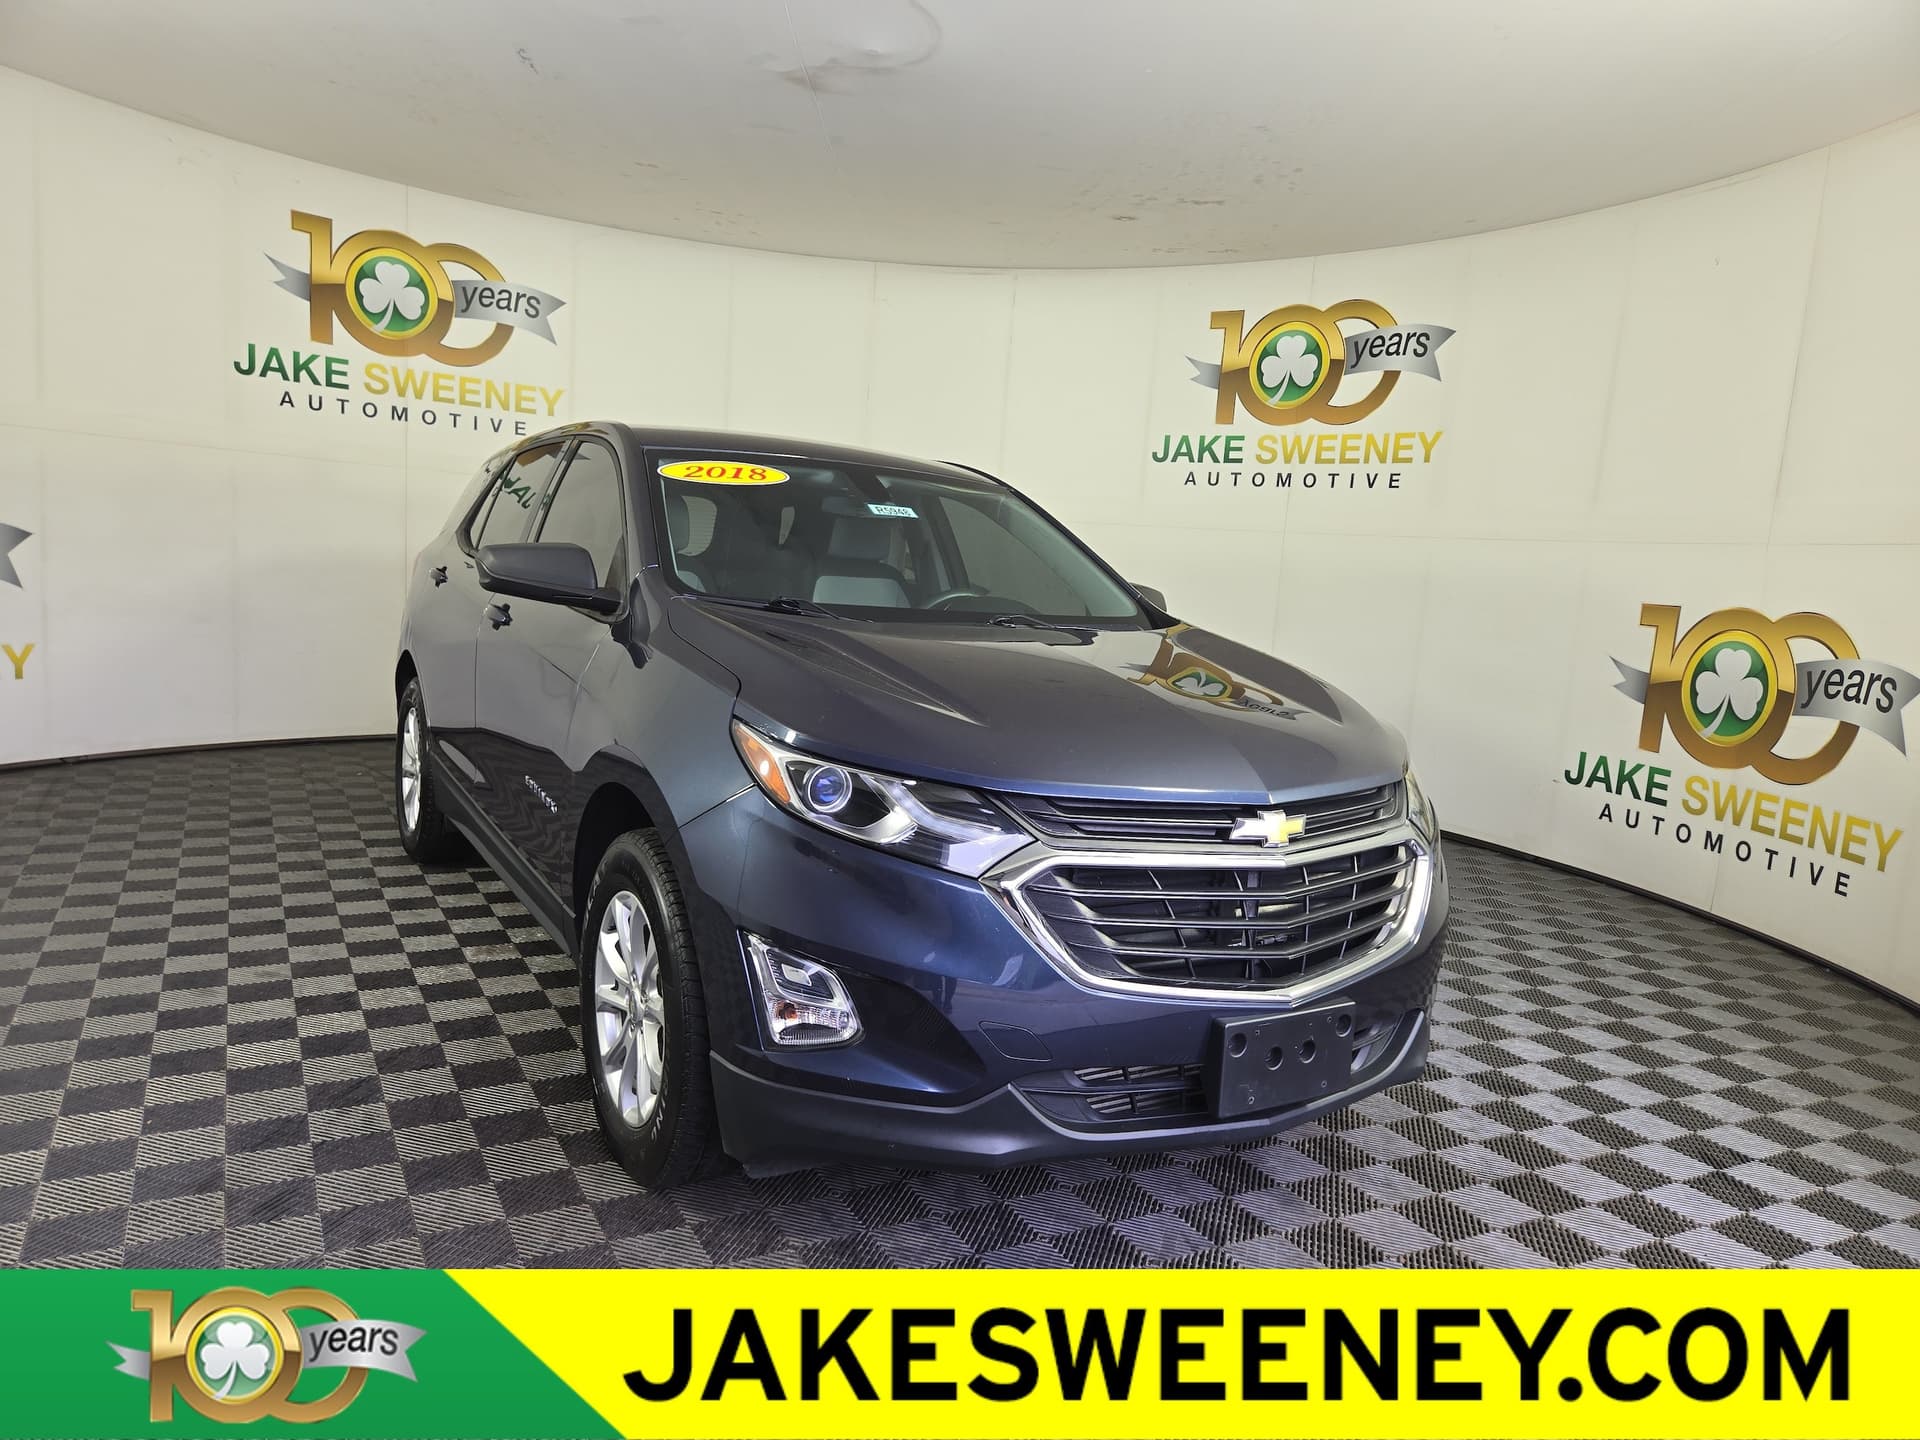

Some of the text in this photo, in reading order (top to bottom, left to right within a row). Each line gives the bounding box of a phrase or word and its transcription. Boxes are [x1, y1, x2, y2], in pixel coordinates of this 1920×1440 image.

[460, 285, 541, 319] years
[1350, 331, 1430, 368] years
[233, 343, 565, 417] JAKE SWEENEY
[279, 390, 528, 436] AUTOMOTIVE
[1152, 431, 1444, 465] JAKE SWEENEY
[683, 465, 767, 481] 2018
[1184, 471, 1401, 489] AUTOMOTIVE
[1800, 668, 1897, 713] years
[1564, 751, 1904, 873] JAKE SWEENEY
[1598, 803, 1851, 897] AUTOMOTIVE
